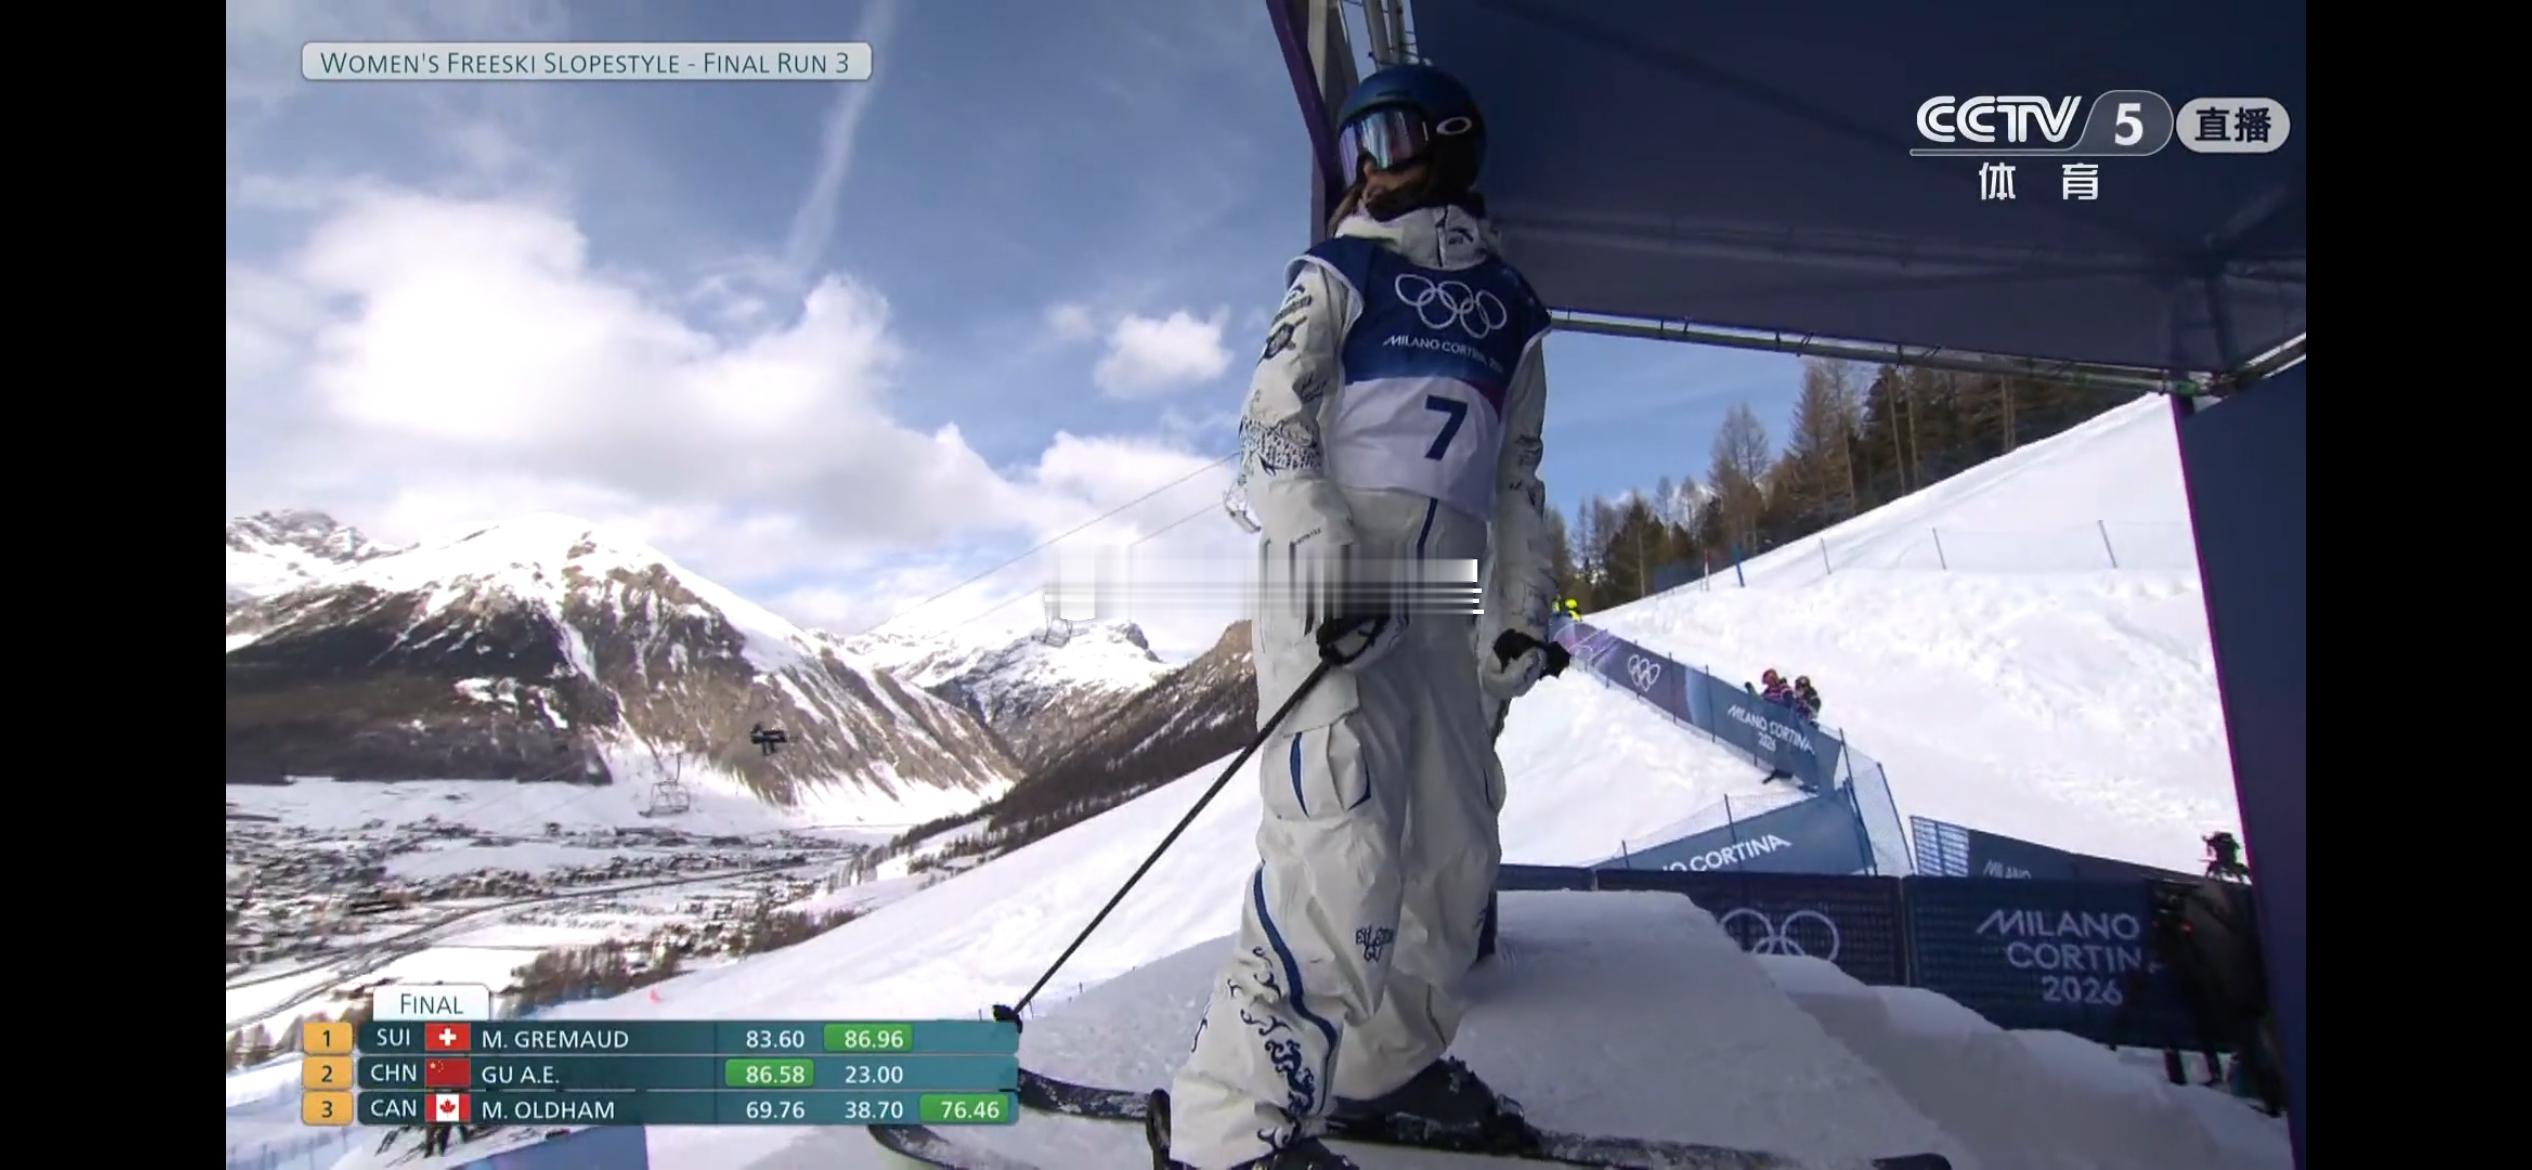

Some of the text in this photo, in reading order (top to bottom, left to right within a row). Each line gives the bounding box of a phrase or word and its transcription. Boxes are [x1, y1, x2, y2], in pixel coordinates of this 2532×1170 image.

[1383, 335, 1440, 350] MILANO
[1424, 394, 1468, 462] 7
[1727, 704, 1816, 755] MILANO CORTINA
[1689, 833, 1793, 872] CORTINA
[1976, 909, 2141, 941] MILANO
[2042, 975, 2124, 1007] 2026
